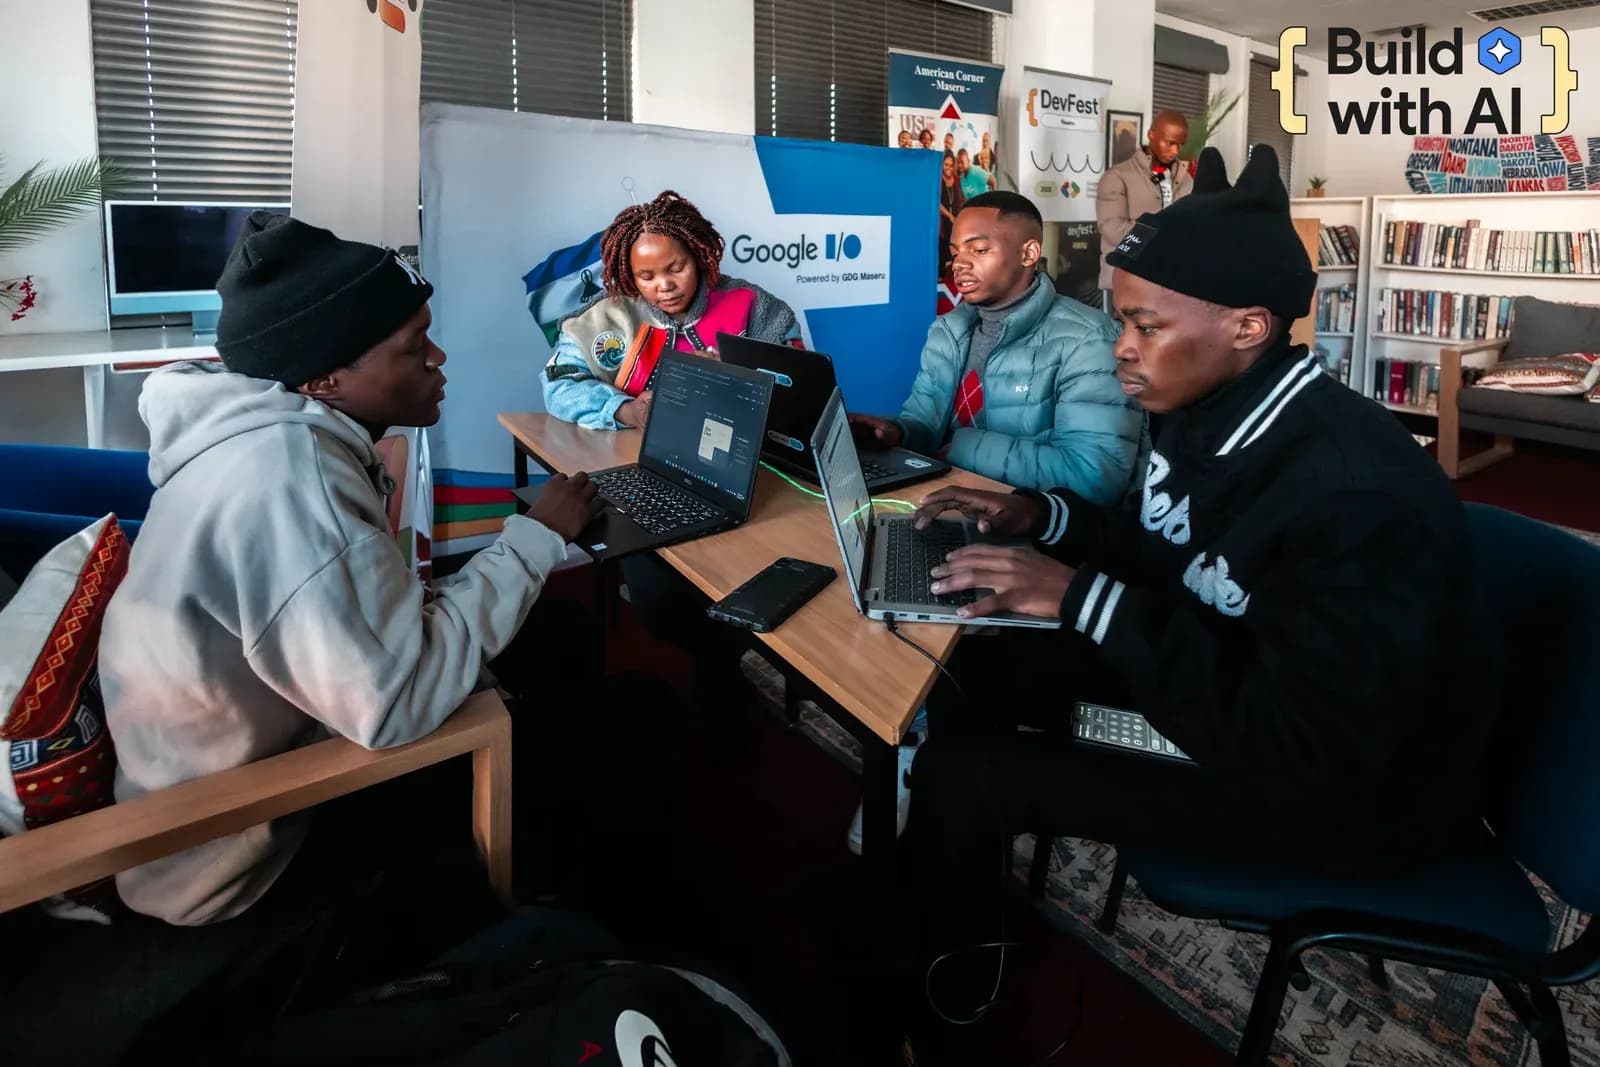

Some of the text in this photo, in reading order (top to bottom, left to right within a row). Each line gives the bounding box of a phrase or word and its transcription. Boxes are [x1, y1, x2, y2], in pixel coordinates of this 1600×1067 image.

[914, 65, 985, 83] American Corner
[1041, 89, 1099, 115] DevFest
[1448, 138, 1498, 158] MONTANA
[1499, 142, 1534, 152] DAKOTA
[1500, 136, 1533, 144] NORTH
[1407, 153, 1442, 171] OREGON
[1441, 139, 1467, 175] IDAHO
[1501, 157, 1536, 167] DAKOTA
[1502, 166, 1539, 178] NEBRASKA
[1537, 161, 1566, 178] IOWA
[1507, 178, 1545, 192] KANSAS
[732, 232, 862, 269] Google I/O
[796, 272, 886, 284] Powered by GDG Maseru
